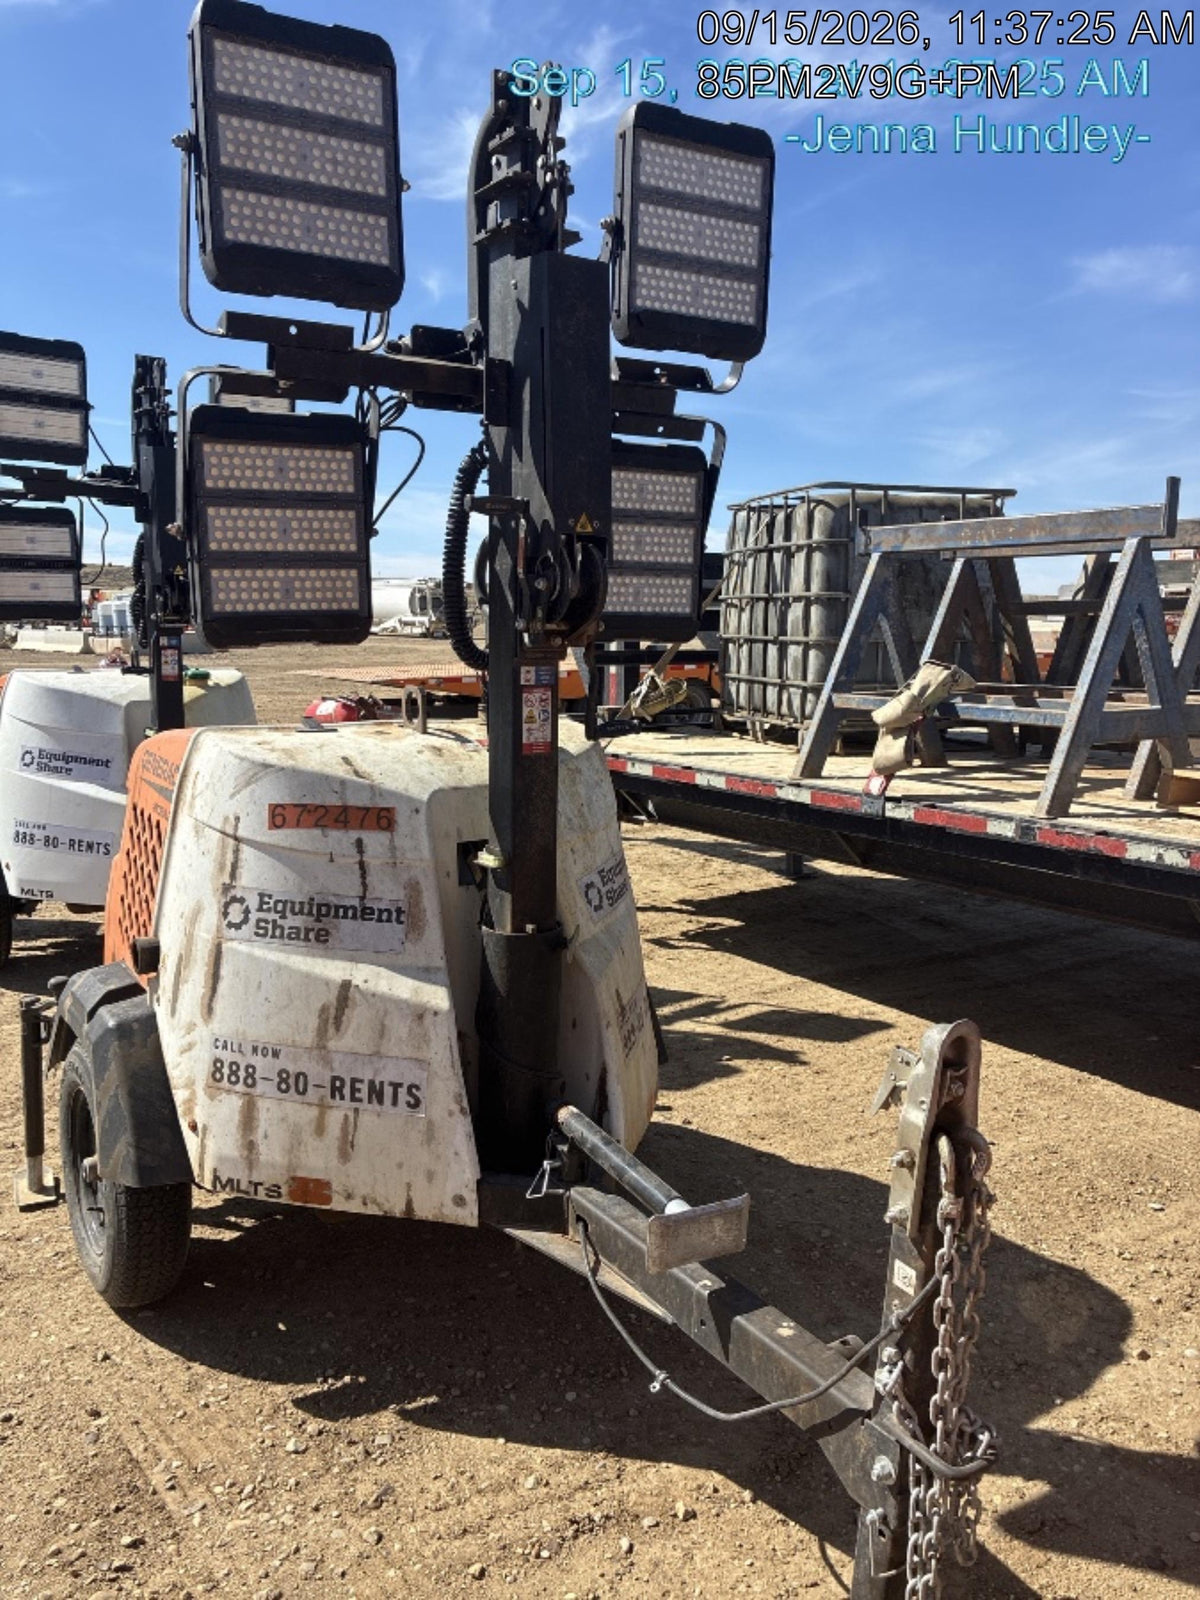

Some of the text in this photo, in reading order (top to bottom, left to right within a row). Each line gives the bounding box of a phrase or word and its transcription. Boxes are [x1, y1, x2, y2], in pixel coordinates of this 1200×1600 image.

[36, 761, 73, 776] Share
[38, 748, 112, 769] Equipment
[271, 804, 392, 831] 672476
[13, 830, 111, 855] 888-80-RENTS
[255, 892, 406, 926] Equipment
[253, 918, 330, 944] Share
[213, 1037, 283, 1060] CALL NOW
[210, 1057, 423, 1110] 888-80-RENTS
[212, 1173, 283, 1199] MLTS
